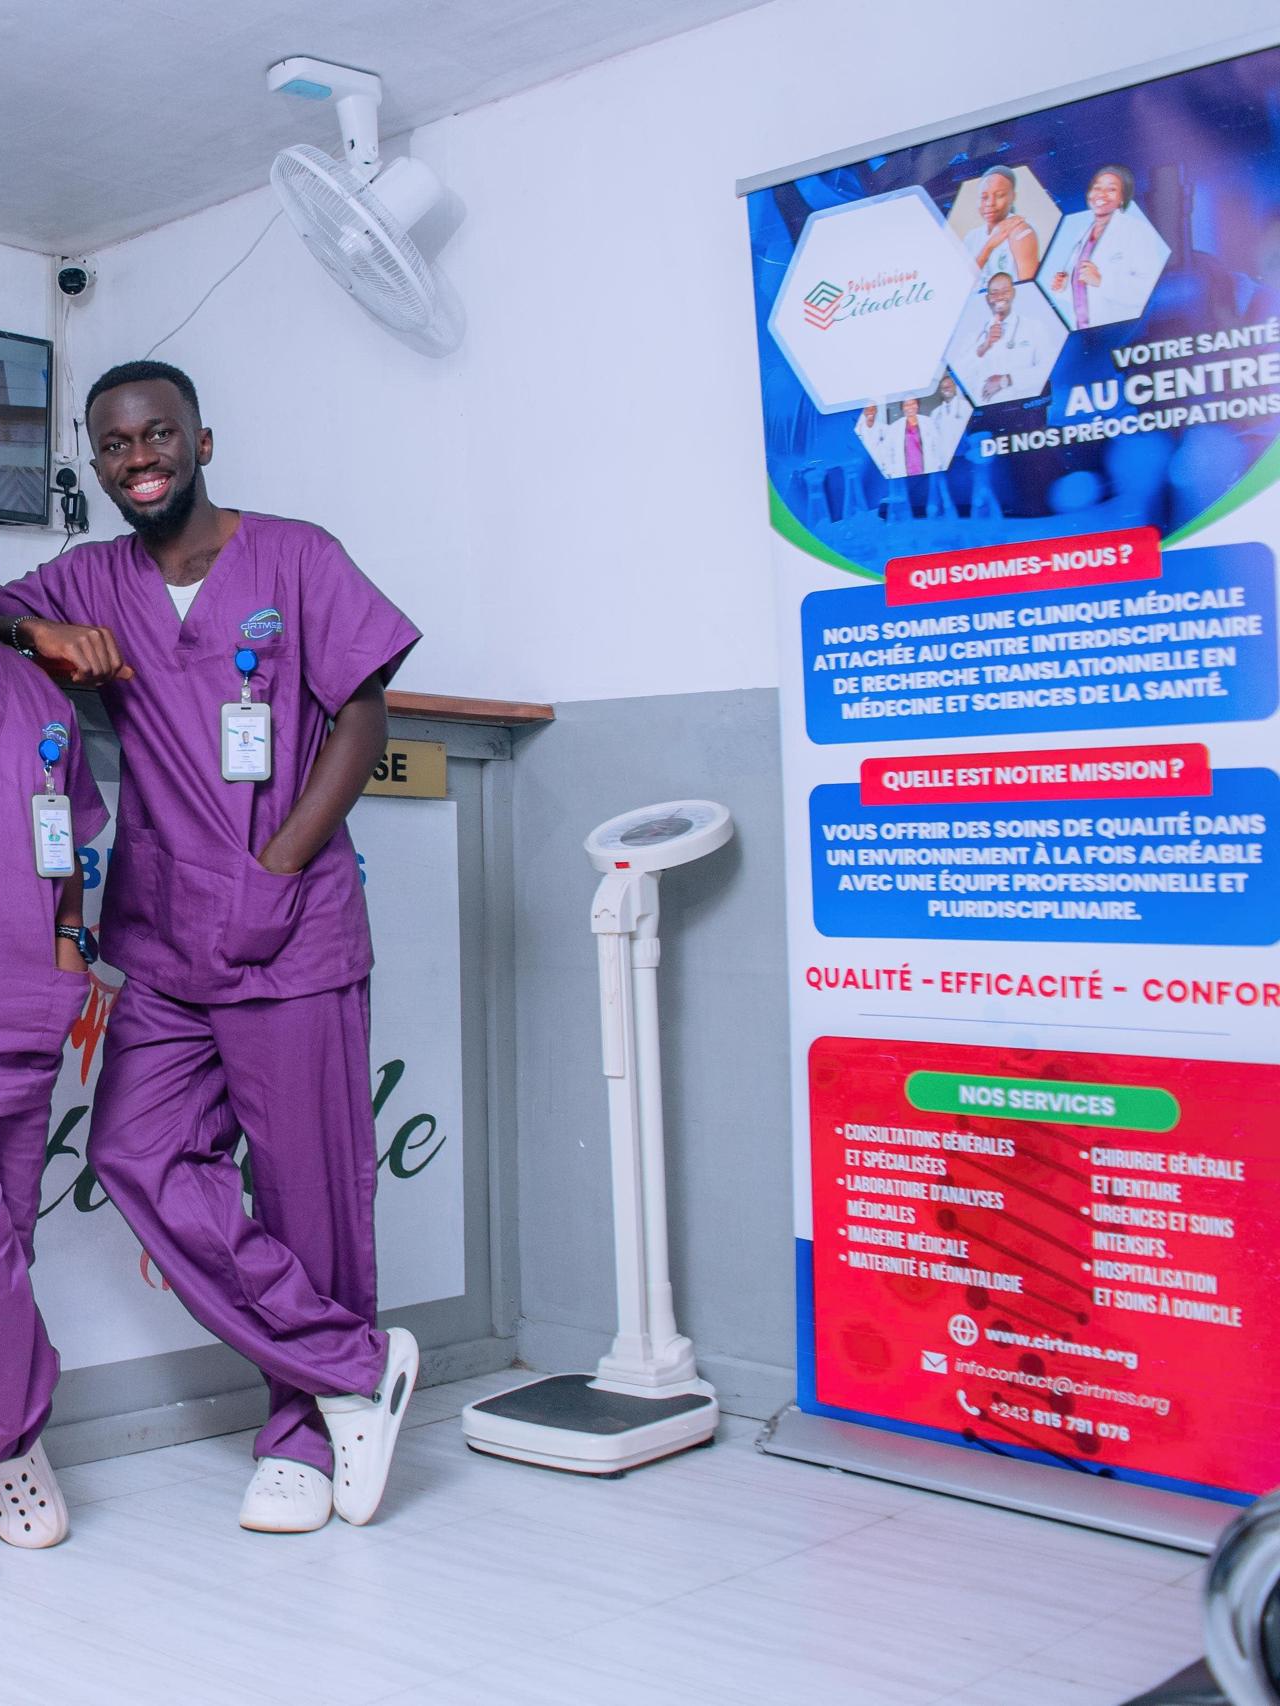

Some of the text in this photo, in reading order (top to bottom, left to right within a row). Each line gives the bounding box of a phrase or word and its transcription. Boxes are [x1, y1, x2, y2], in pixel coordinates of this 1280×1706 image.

[1112, 317, 1280, 368] VOTRE SANTÉ
[1065, 353, 1280, 417] AU CENTRE
[981, 394, 1280, 458] DE NOS PRÉOCCUPATIONS
[910, 544, 1133, 588] QUI SOMMES-NOUS ?
[823, 587, 1245, 645] NOUS SOMMES UNE CLINIQUE MÉDICALE
[813, 615, 1262, 672] ATTACHÉE AU CENTRE INTERDISCIPLINAIRE
[833, 646, 1237, 695] DE RECHERCHE TRANSLATIONNELLE EN
[841, 671, 1228, 720] MÉDECINE ET SCIENCES DE LA SANTÉ.
[882, 758, 1184, 791] QUELLE EST NOTRE MISSION ?
[822, 811, 1266, 842] VOUS OFFRIR DES SOINS DE QUALITÉ DANS
[826, 840, 1262, 867] UN ENVIRONNEMENT À LA FOIS AGRÉABLE
[838, 869, 1249, 894] AVEC UNE ÉQUIPE PROFESSIONNELLE ET
[928, 900, 1142, 920] PLURIDISCIPLINAIRE.
[805, 963, 912, 992] QUALITÉ
[940, 969, 1103, 1000] EFFICACITÉ
[1142, 979, 1280, 1008] CONFOR
[959, 1085, 1116, 1117] NOS SERVICES
[844, 1123, 1015, 1157] CONSULTATIONS GÉNÉRALES
[845, 1149, 947, 1176] ET SPÉCIALISÉES
[1091, 1147, 1244, 1181] CHIRURGIE GÉNÉRALE
[847, 1175, 1004, 1209] LABORATOIRE D'ANALYSES
[1092, 1176, 1182, 1203] ET DENTAIRE
[847, 1198, 915, 1224] MÉDICALES
[1093, 1205, 1234, 1238] URGENCES ET SOINS
[848, 1225, 968, 1258] IMAGERIE MÉDICALE
[849, 1251, 918, 1276] MATERNITÉ
[930, 1261, 1023, 1293] NÉONATALOGIE
[1094, 1261, 1217, 1294] HOSPITALISATION
[1095, 1288, 1242, 1327] ET SOINS À DOMICILE
[985, 1327, 1138, 1369] www.cirtmss.org
[955, 1358, 1170, 1416] info.contact@cirtmss.org
[989, 1402, 1130, 1441] +243 815 791 076
